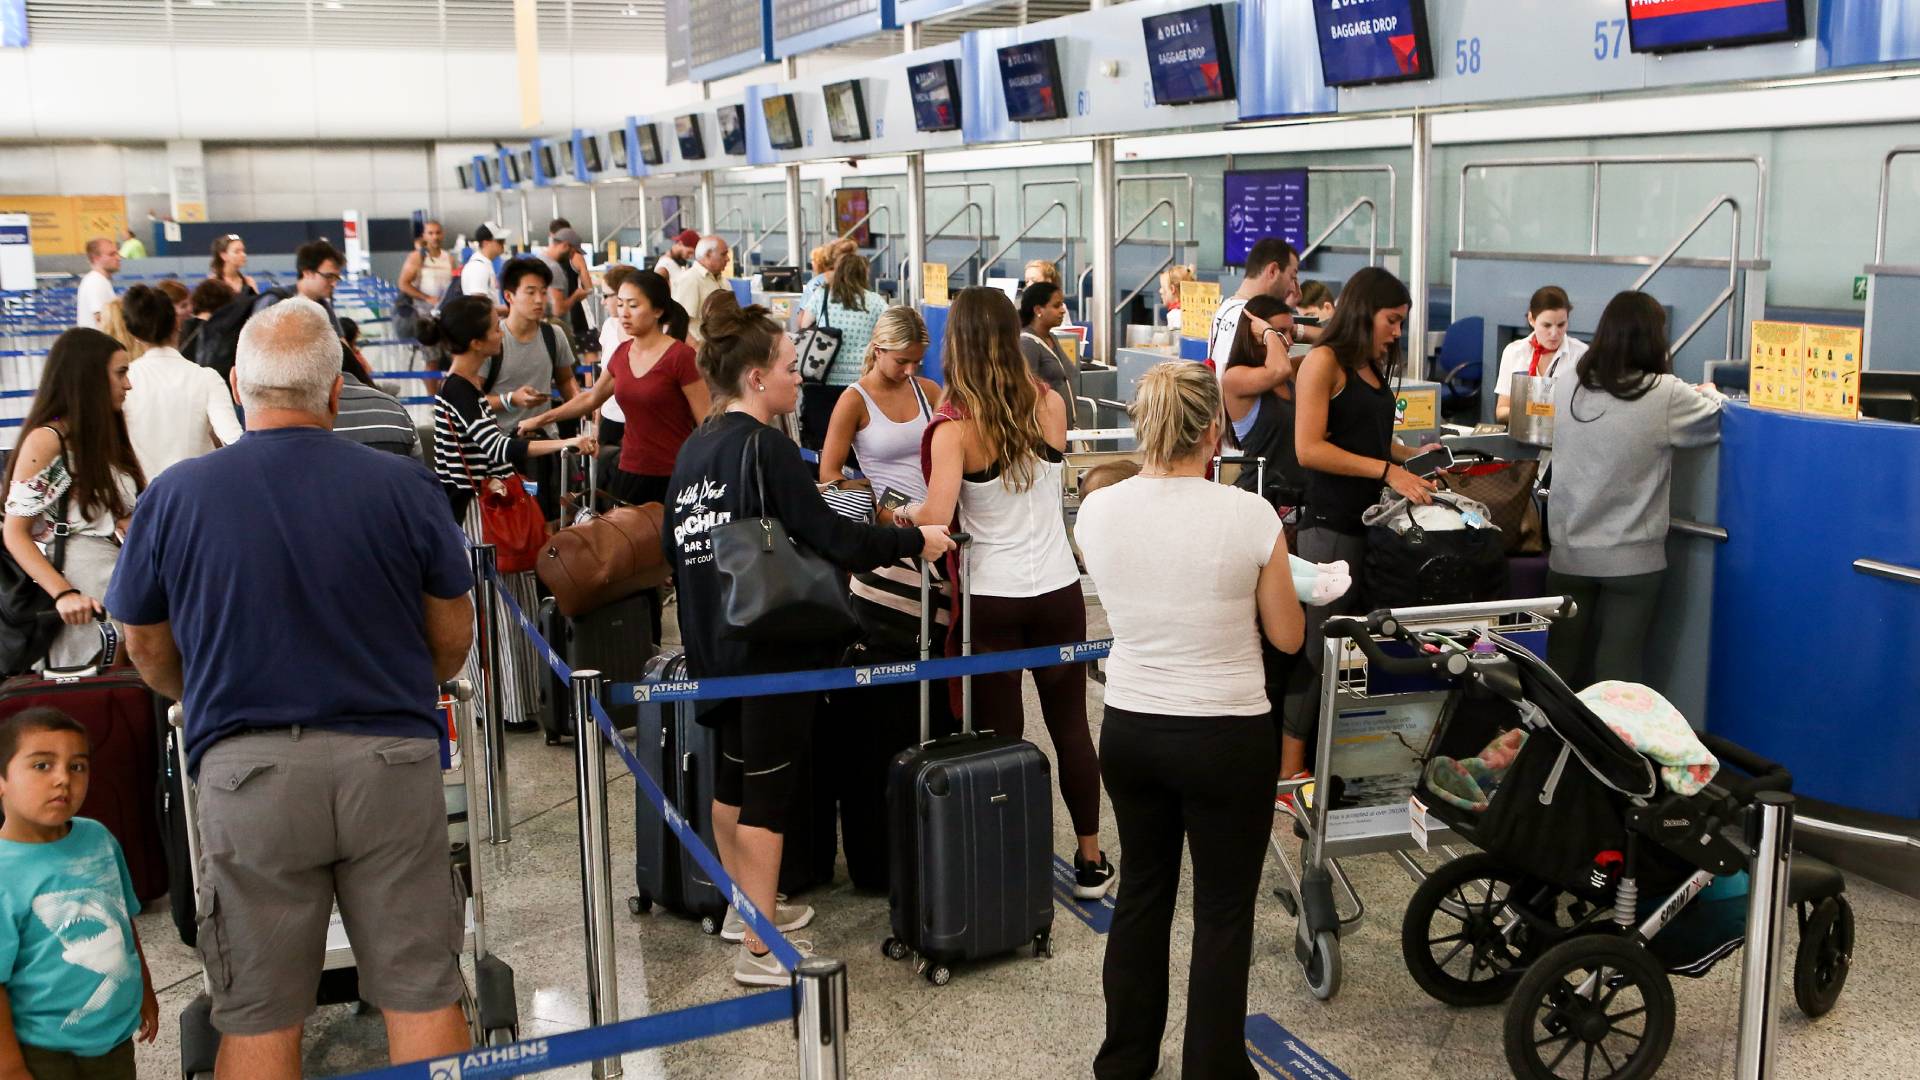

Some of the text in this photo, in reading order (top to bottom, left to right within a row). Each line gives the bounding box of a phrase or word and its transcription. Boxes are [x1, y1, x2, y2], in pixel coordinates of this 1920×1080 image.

[1164, 22, 1192, 38] DELTA
[1331, 16, 1398, 39] BAGGAGE DROP
[1594, 18, 1626, 61] 57
[1158, 46, 1206, 65] BAGGAGE DROP
[1456, 37, 1481, 75] 58
[684, 540, 702, 553] BAR
[872, 663, 917, 675] ATHENS
[651, 681, 699, 693] ATHENS
[463, 1040, 549, 1070] ATHENS
